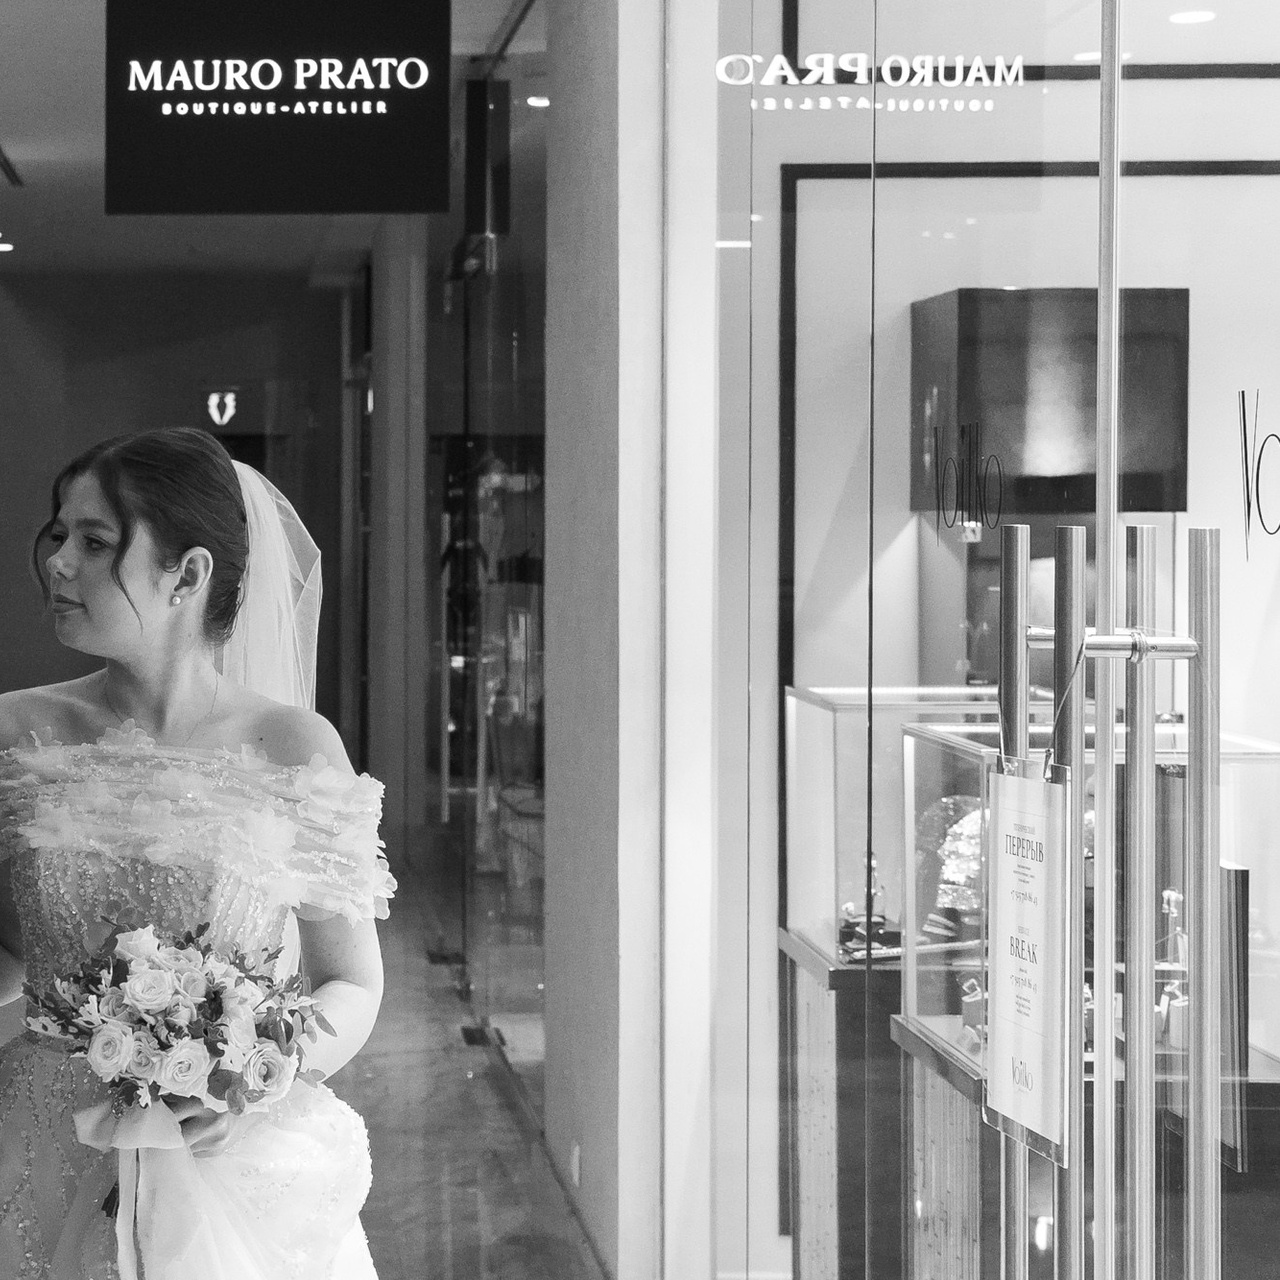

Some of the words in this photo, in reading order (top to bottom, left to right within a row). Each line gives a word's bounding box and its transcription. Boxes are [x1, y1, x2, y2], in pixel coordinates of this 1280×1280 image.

[127, 58, 283, 92] MAURO
[293, 56, 430, 90] PRATO
[161, 100, 389, 116] BOUTIQUE-ATELIER
[1005, 834, 1044, 863] ПЕРЕРЫВ
[1009, 935, 1038, 965] BREAK
